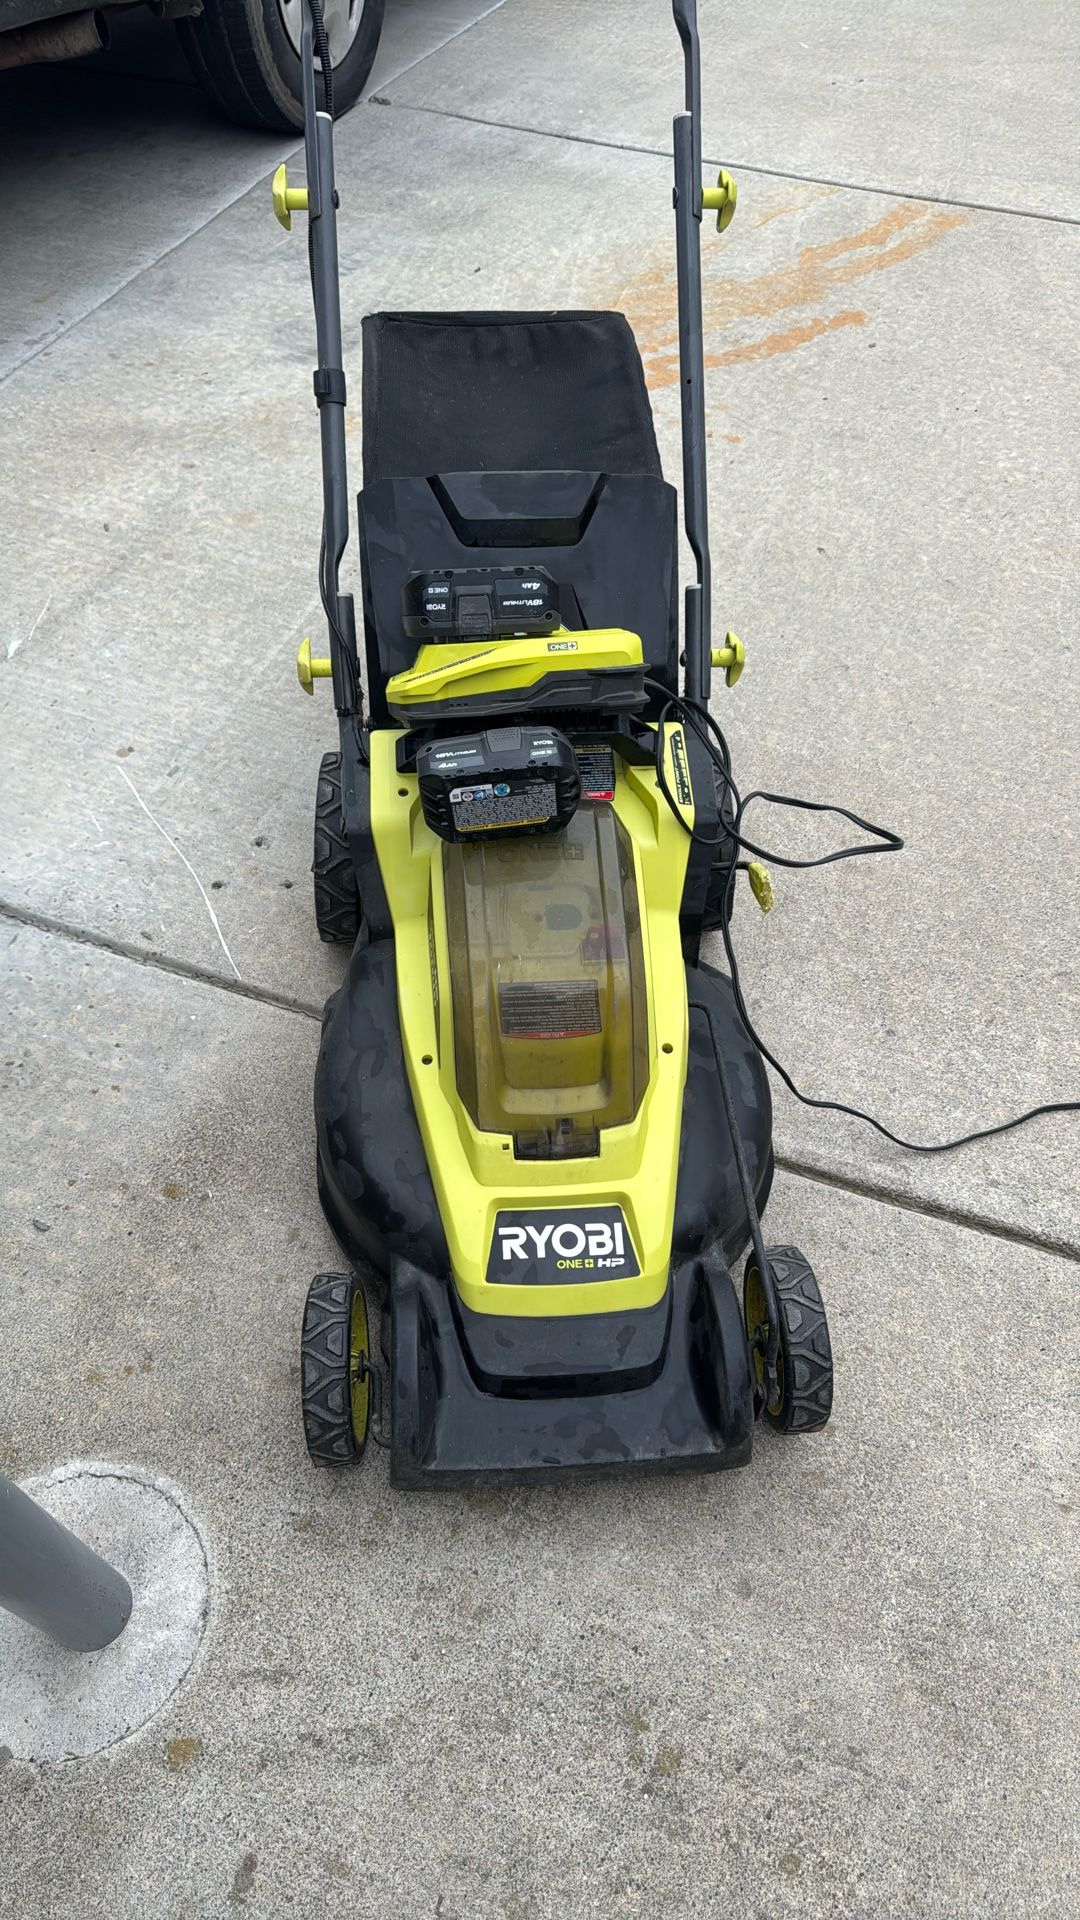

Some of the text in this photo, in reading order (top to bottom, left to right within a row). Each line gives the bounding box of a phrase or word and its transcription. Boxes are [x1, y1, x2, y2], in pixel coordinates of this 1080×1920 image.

[426, 603, 446, 611] RYOBI
[498, 1222, 625, 1260] RYOBI
[597, 1257, 625, 1268] HP
